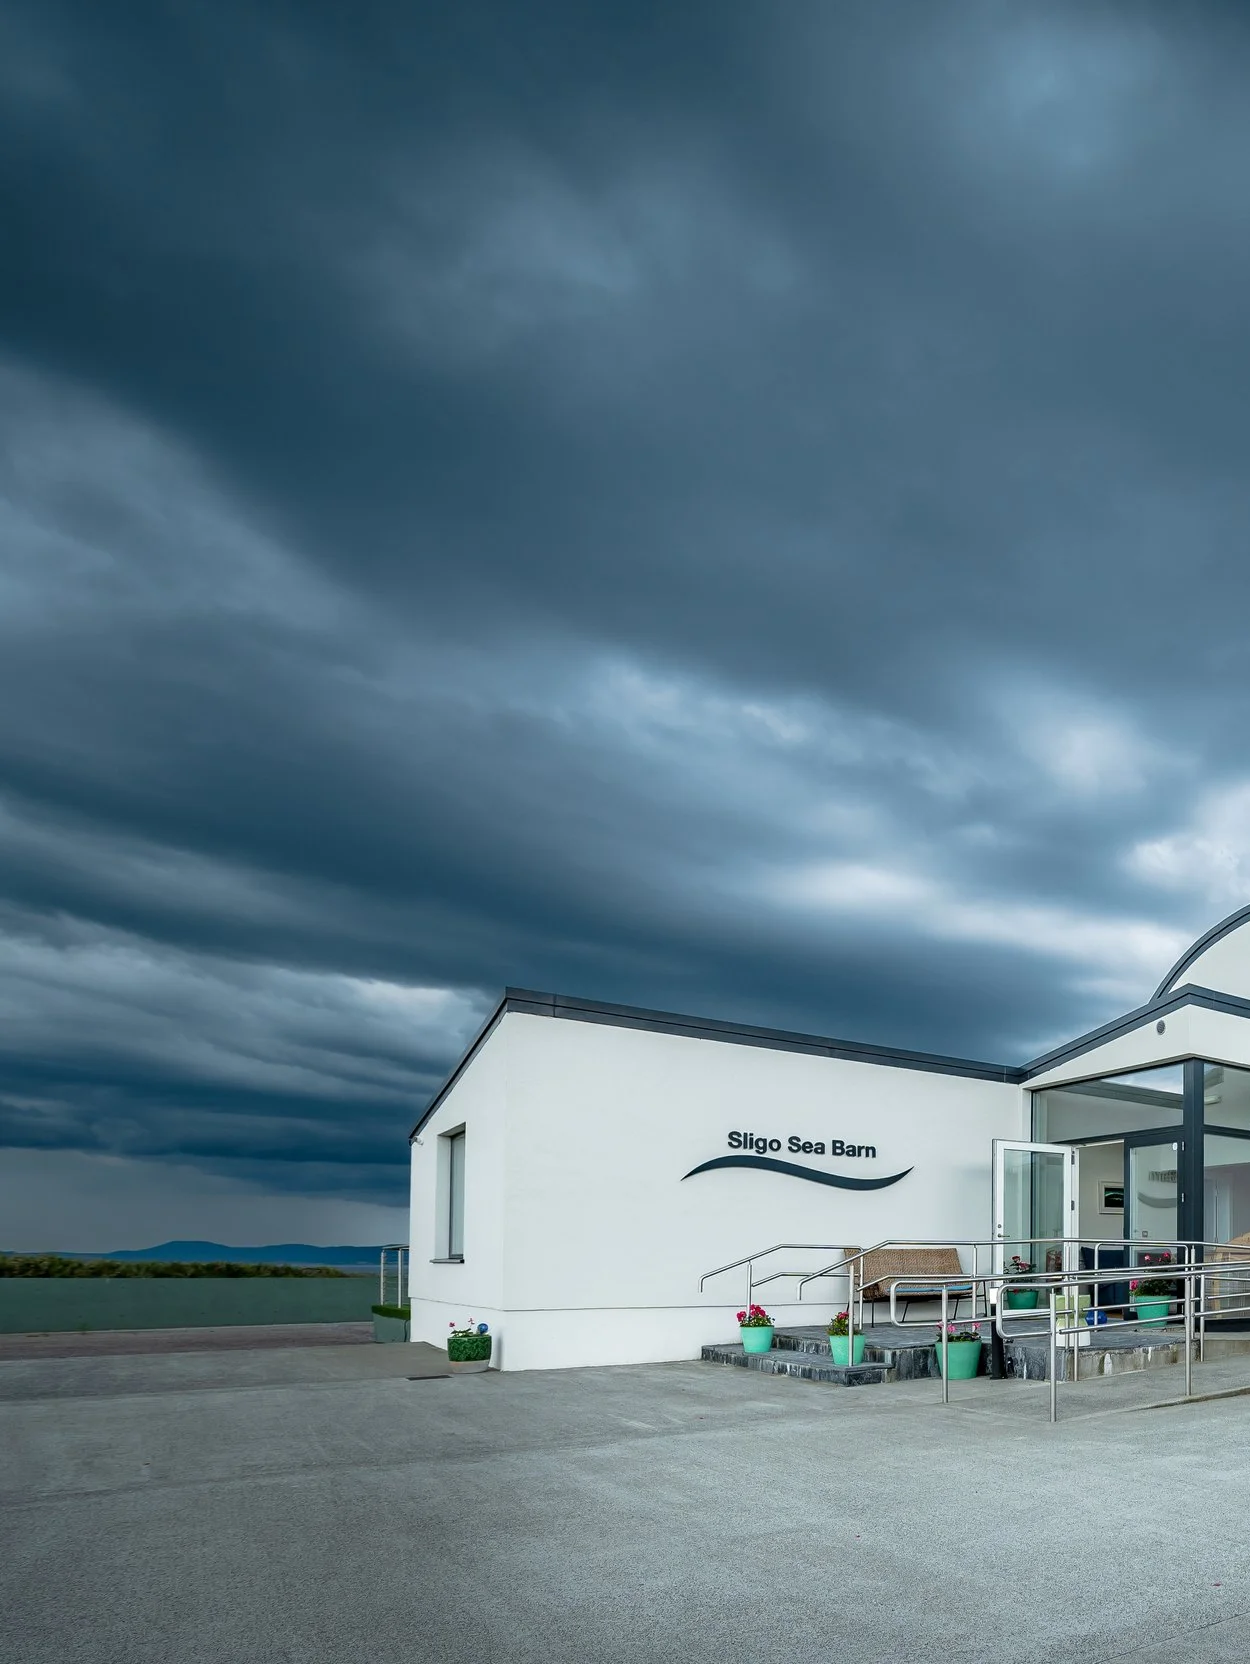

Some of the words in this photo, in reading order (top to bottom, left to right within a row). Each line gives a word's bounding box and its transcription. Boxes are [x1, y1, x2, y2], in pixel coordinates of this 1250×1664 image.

[727, 1130, 782, 1155] Sligo
[787, 1135, 826, 1155] Sea
[831, 1139, 877, 1158] Barn
